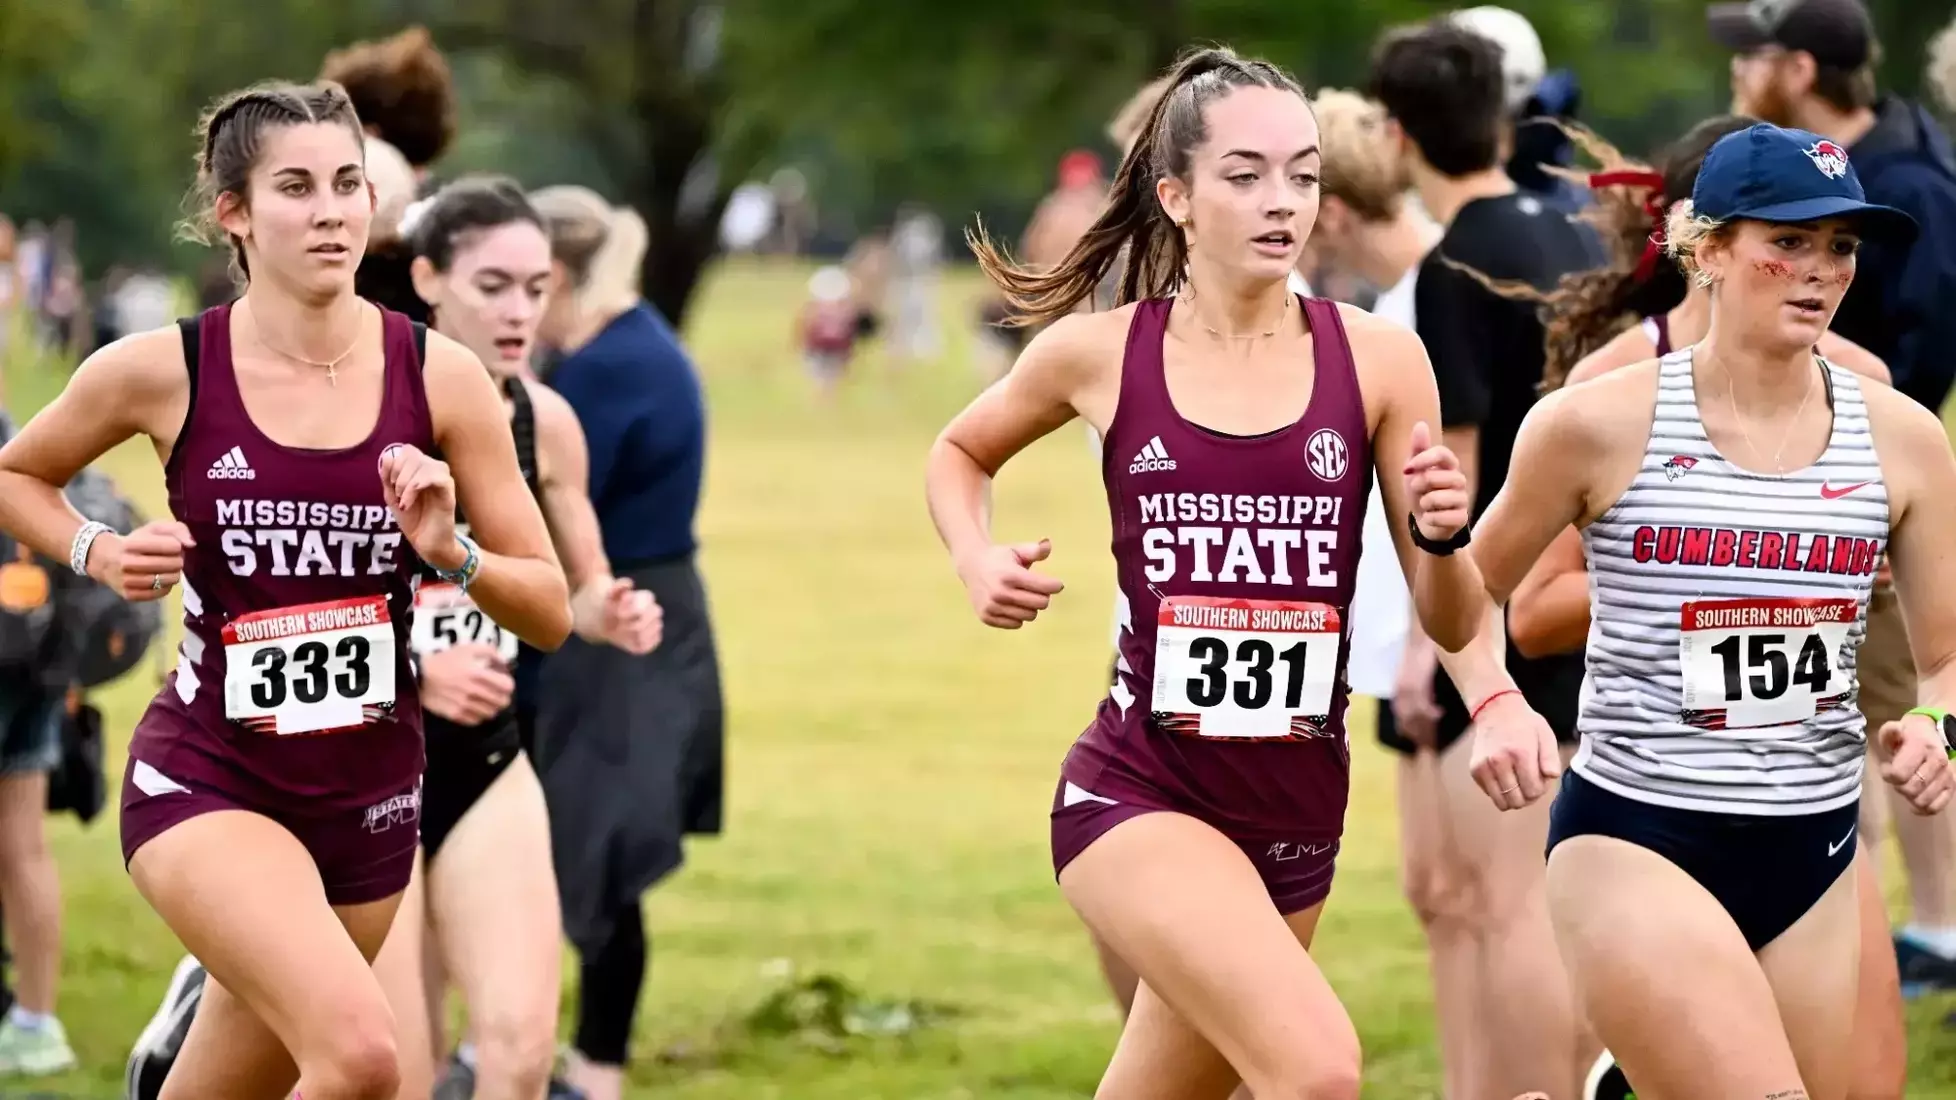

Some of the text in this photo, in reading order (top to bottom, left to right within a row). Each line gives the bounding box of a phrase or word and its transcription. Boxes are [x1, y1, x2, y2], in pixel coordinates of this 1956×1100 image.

[207, 466, 256, 480] adidas
[1129, 458, 1177, 474] adidas
[1308, 432, 1346, 478] SEC
[216, 499, 397, 530] MISSISSIPP
[1138, 493, 1343, 526] MISSISSIPPI
[220, 529, 402, 577] STATE
[1142, 526, 1338, 587] STATE
[1633, 526, 1878, 576] CUMBERLANDS
[235, 604, 379, 643] SOUTHERN SHOWCASE
[1173, 605, 1327, 632] SOUTHERN SHOWCASE
[1695, 604, 1843, 629] SOUTHERN SHOWCASE
[250, 636, 371, 709] 333
[1186, 636, 1308, 710] 331
[1710, 633, 1832, 702] 154
